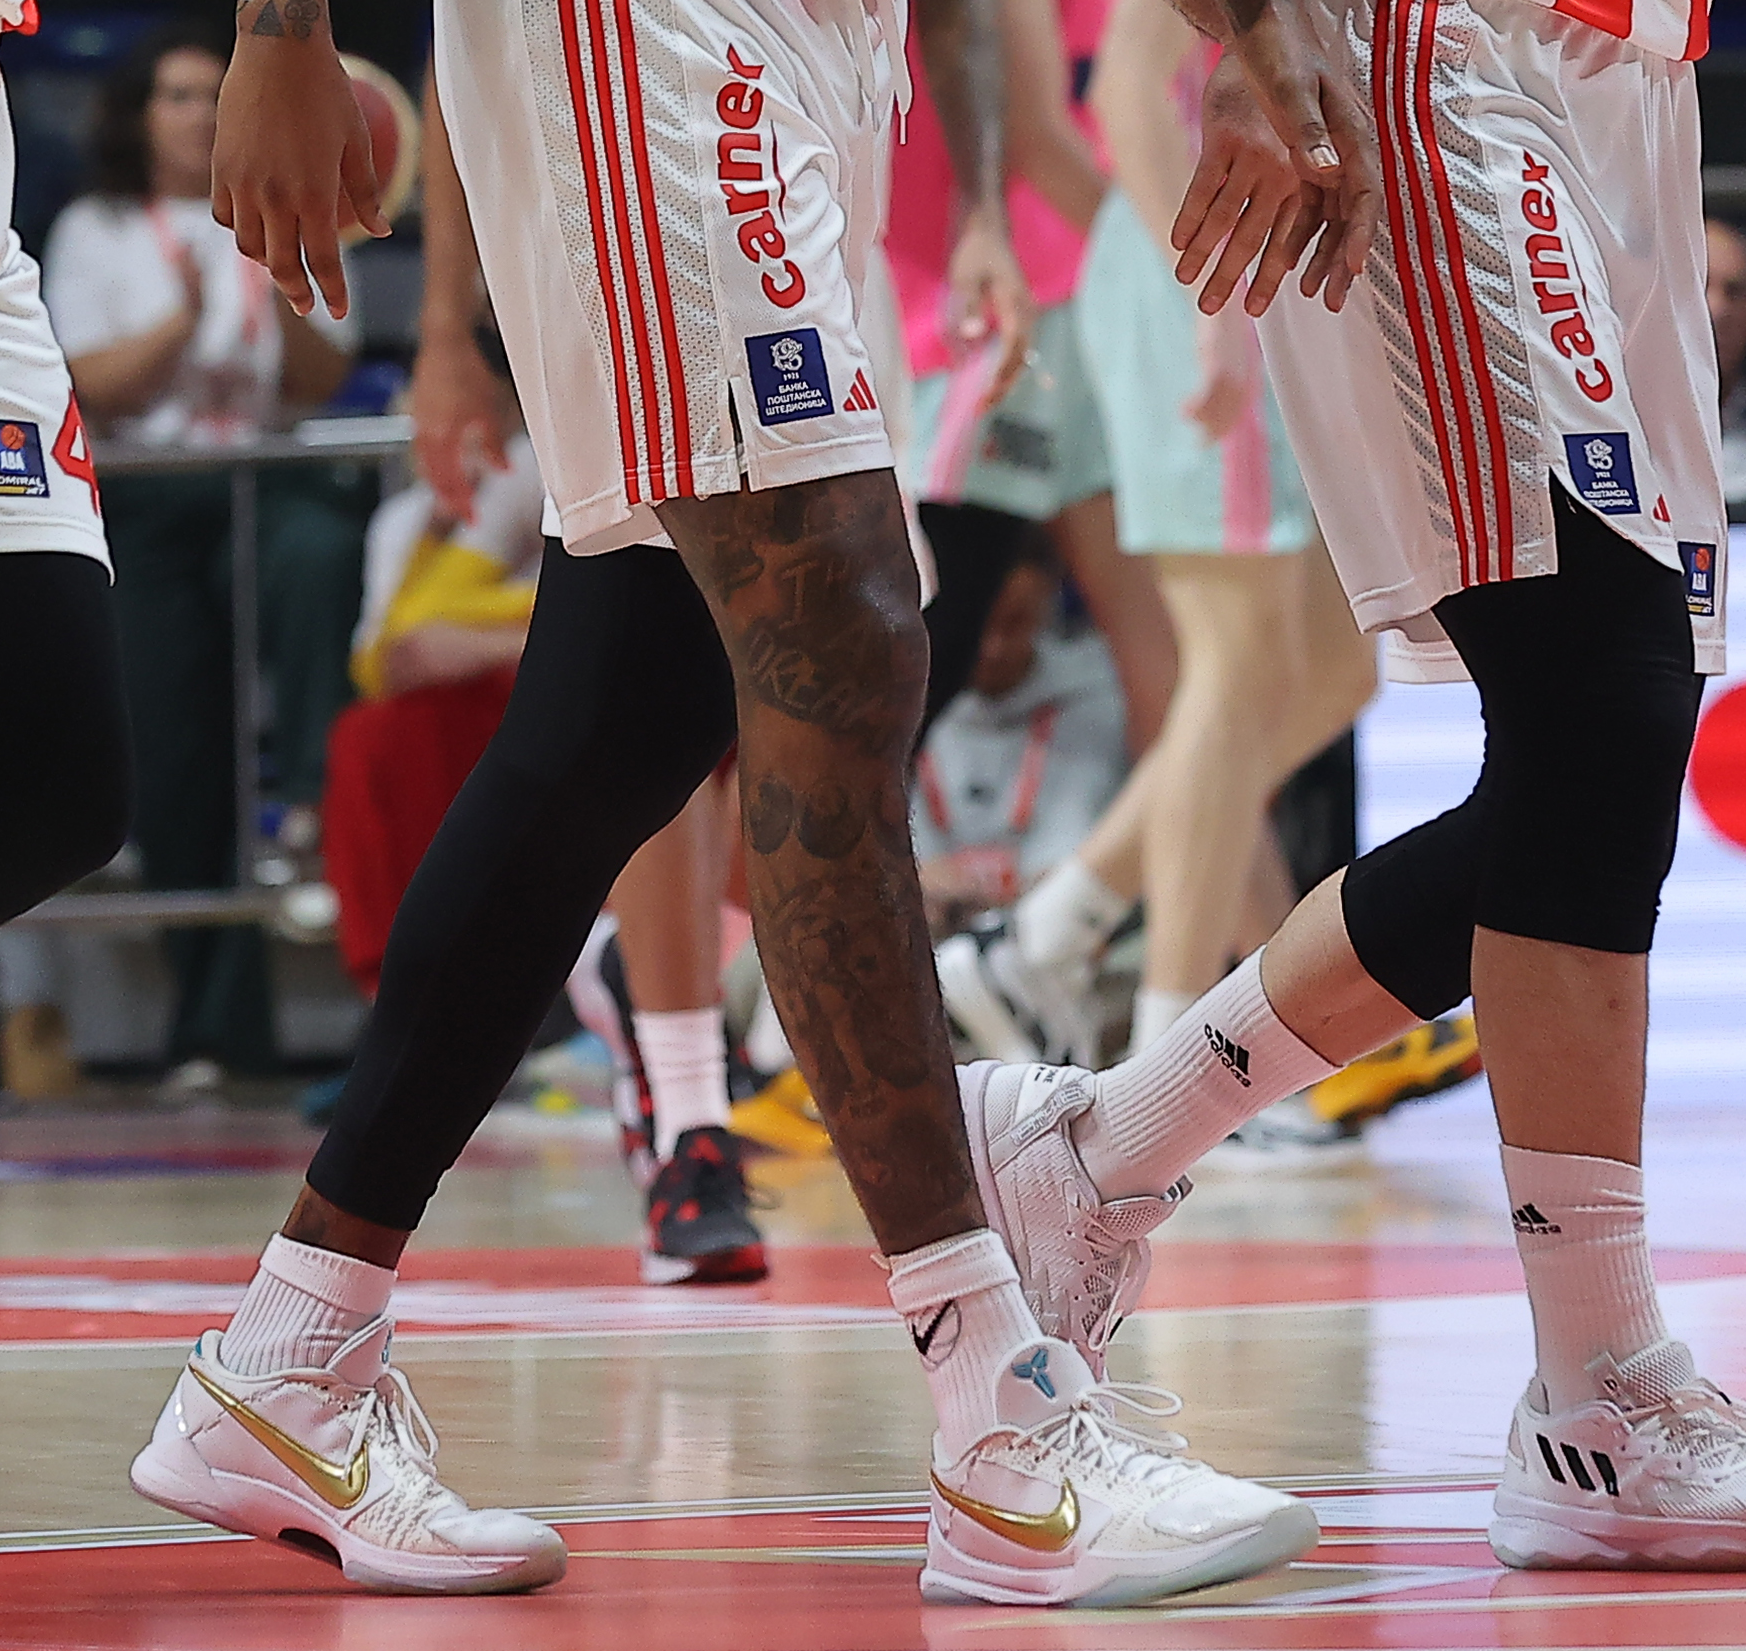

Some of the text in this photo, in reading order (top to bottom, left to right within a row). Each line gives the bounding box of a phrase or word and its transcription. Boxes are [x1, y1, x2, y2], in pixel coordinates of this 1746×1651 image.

[1521, 148, 1614, 403] carnex
[778, 381, 809, 394] БАНКА
[765, 398, 827, 416] ШТЕДИОНИЦА
[767, 389, 822, 406] ПОШТАНСКА
[0, 450, 26, 471] ABA
[1204, 1023, 1252, 1088] adidas
